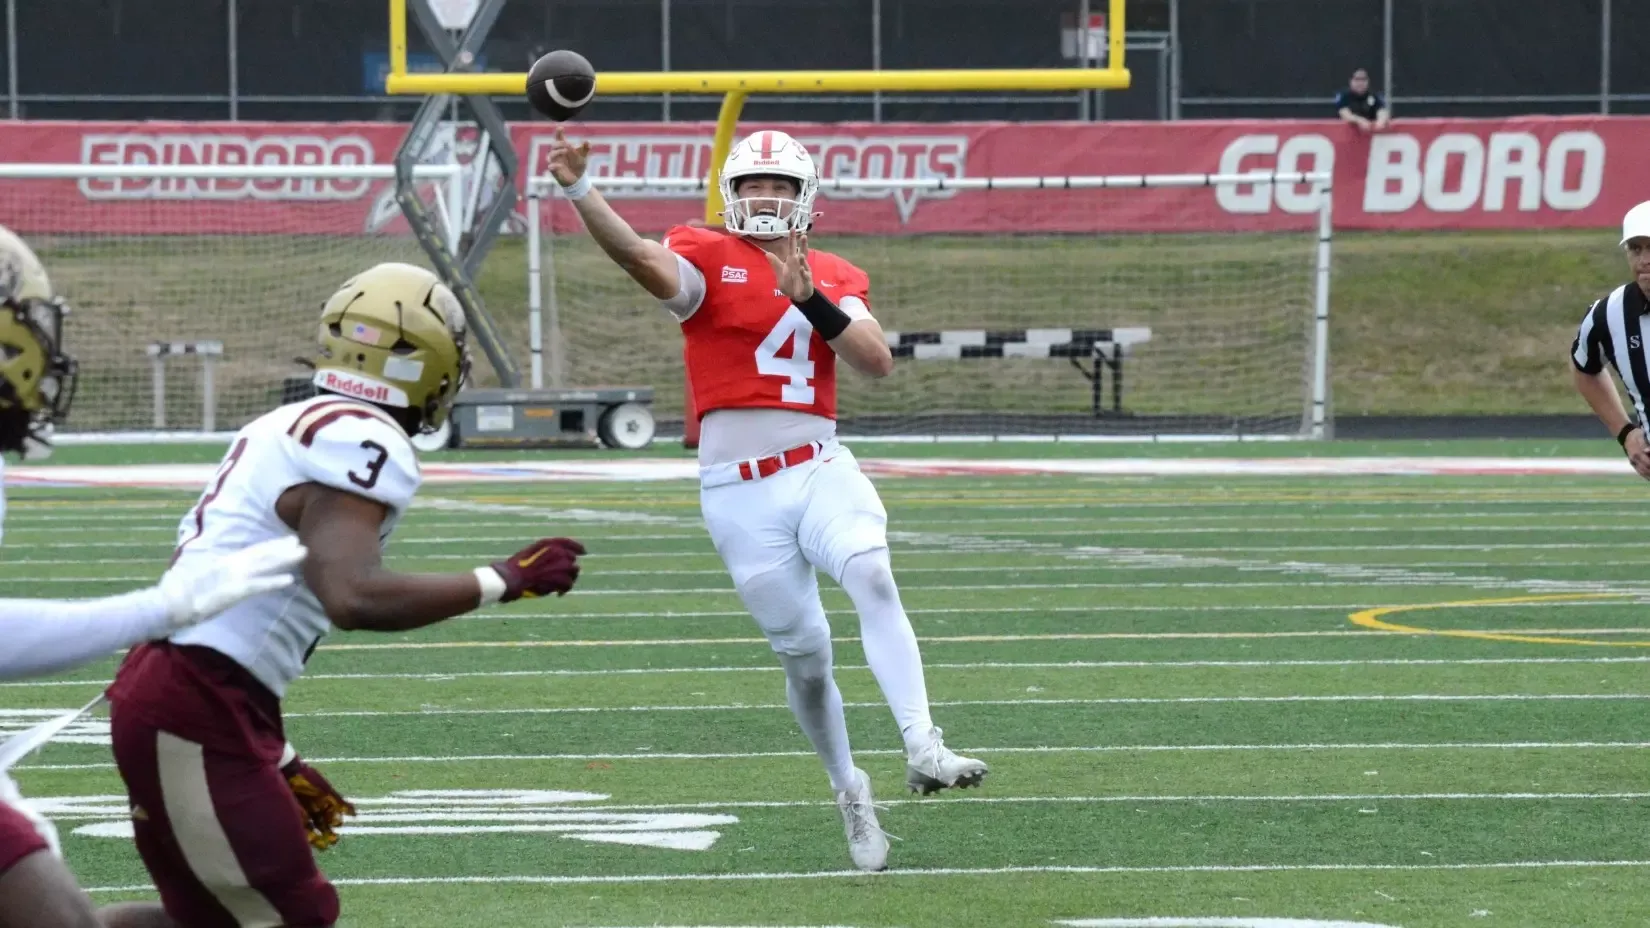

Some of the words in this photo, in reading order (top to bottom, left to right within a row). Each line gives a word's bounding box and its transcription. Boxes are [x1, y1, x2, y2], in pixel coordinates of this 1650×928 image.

[78, 134, 375, 199] EDINBORO
[797, 135, 968, 222] COTS
[1215, 134, 1335, 214] GO
[1362, 131, 1606, 213] BORO
[721, 270, 748, 280] PSAC
[754, 303, 815, 405] 4
[1630, 335, 1640, 349] S
[325, 373, 389, 401] Riddell
[347, 440, 388, 489] 3
